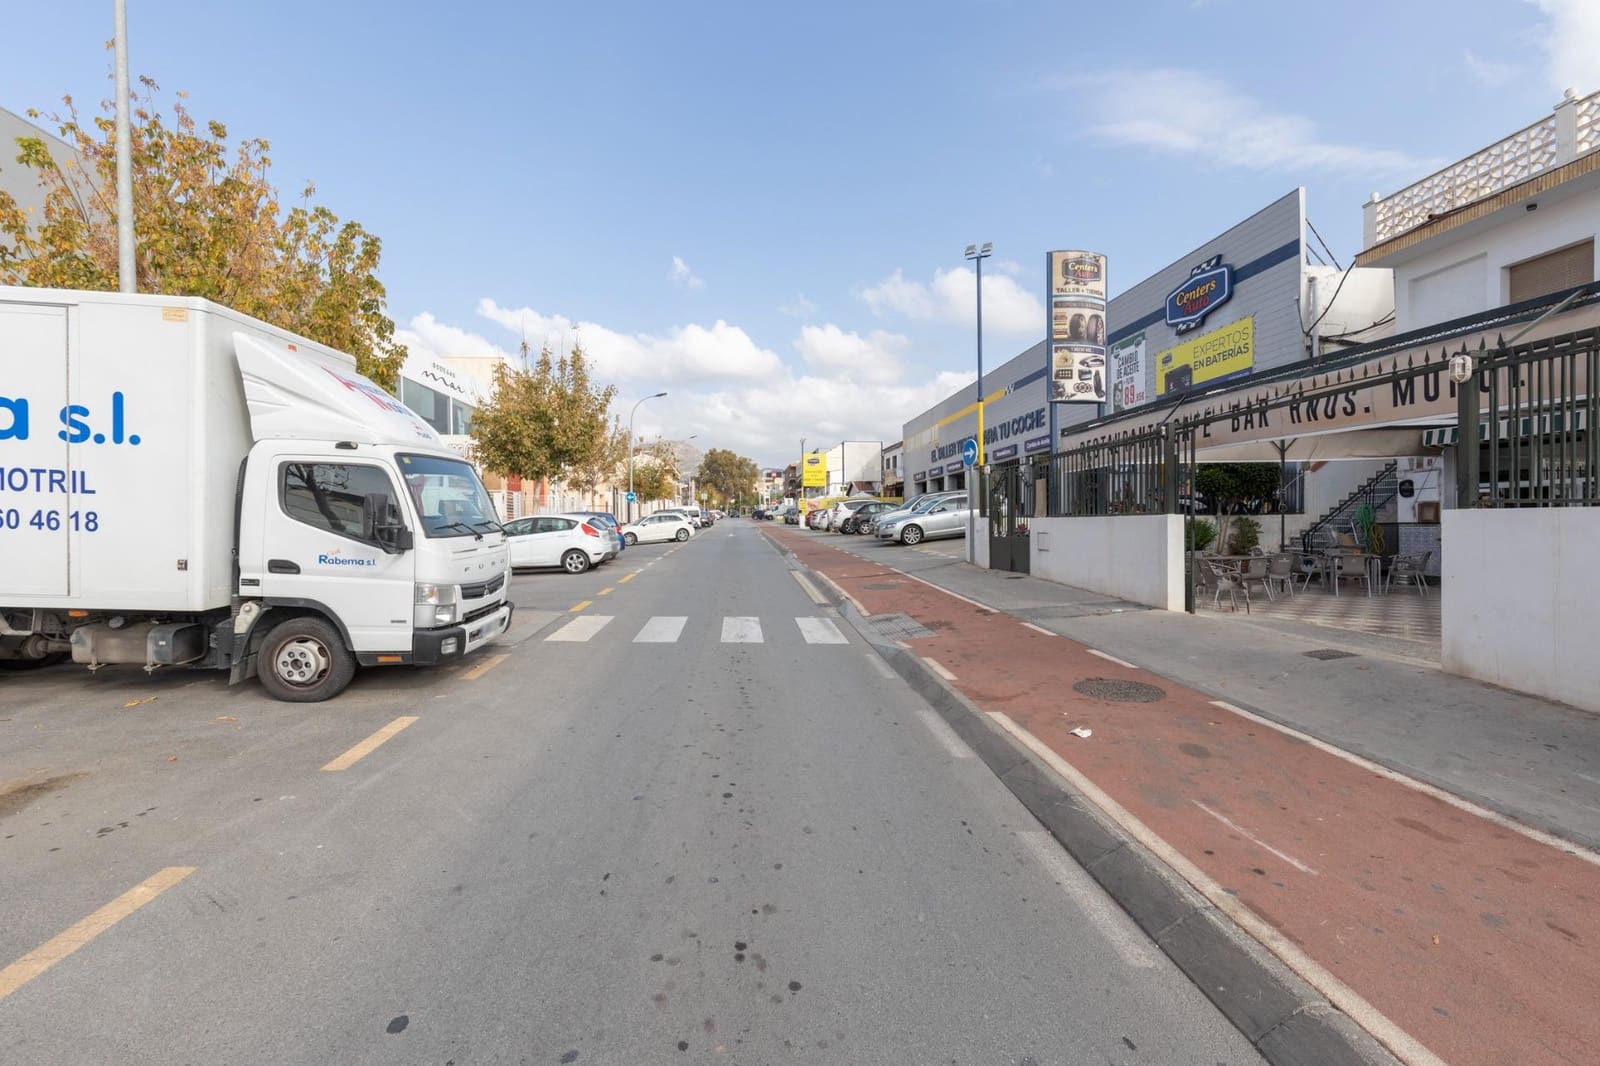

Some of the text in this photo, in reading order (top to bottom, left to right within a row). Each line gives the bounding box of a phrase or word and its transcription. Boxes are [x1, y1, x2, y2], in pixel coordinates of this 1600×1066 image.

[1068, 262, 1098, 273] Centers
[1075, 271, 1095, 279] Auto
[1176, 279, 1216, 306] Centers
[1184, 295, 1209, 316] Auto
[1193, 326, 1250, 359] EXPERTOS
[1118, 350, 1138, 368] CAMBIO
[1124, 361, 1140, 376] ACEITE
[1193, 343, 1250, 371] EN BATERÍAS
[58, 391, 141, 446] s.l.
[998, 420, 1010, 440] TU
[1011, 407, 1046, 437] COCHE
[1232, 398, 1269, 433] BAR
[29, 509, 60, 531] 46
[69, 511, 99, 532] 18
[318, 554, 364, 566] Rabema
